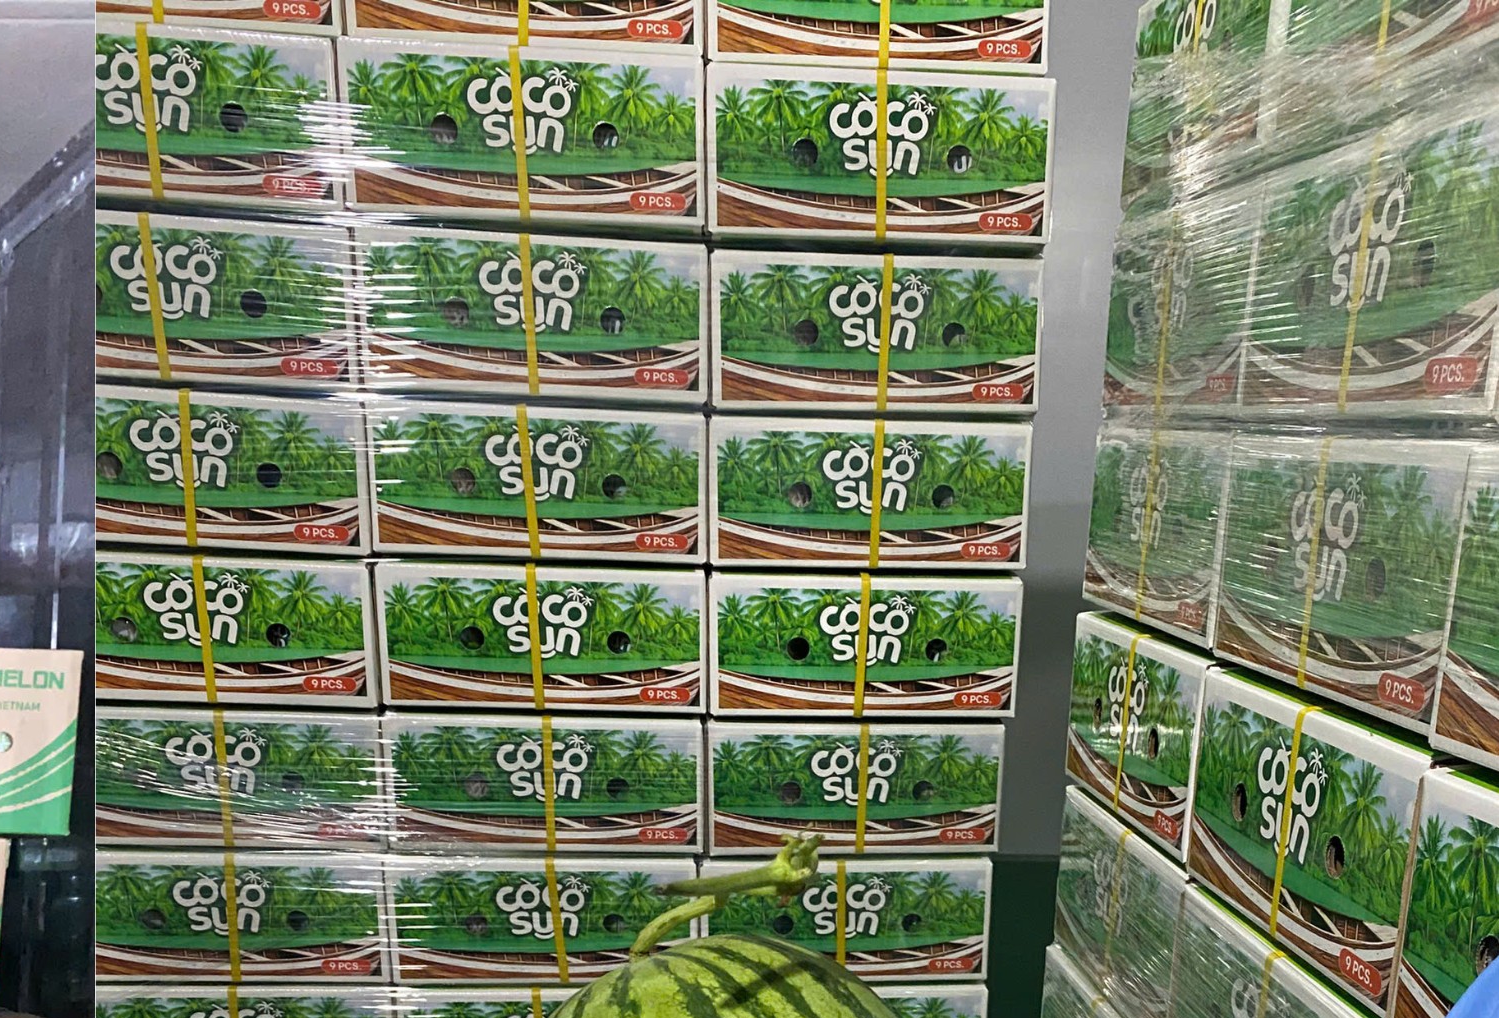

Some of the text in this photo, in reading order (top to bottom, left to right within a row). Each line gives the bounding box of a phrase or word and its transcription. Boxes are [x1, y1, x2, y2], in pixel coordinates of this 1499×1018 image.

[637, 23, 672, 35] 9 PCS.
[987, 43, 1020, 54] 9 PCS.
[988, 217, 1021, 227] 9 PCS.
[303, 528, 339, 539] 9 PCS.
[644, 537, 677, 547] 9 PCS.
[312, 679, 346, 690] 9 PCS.
[1386, 679, 1414, 704] 9 PCS.
[962, 695, 992, 704] 9 PCS.
[1346, 955, 1373, 987] 9 PCS.
